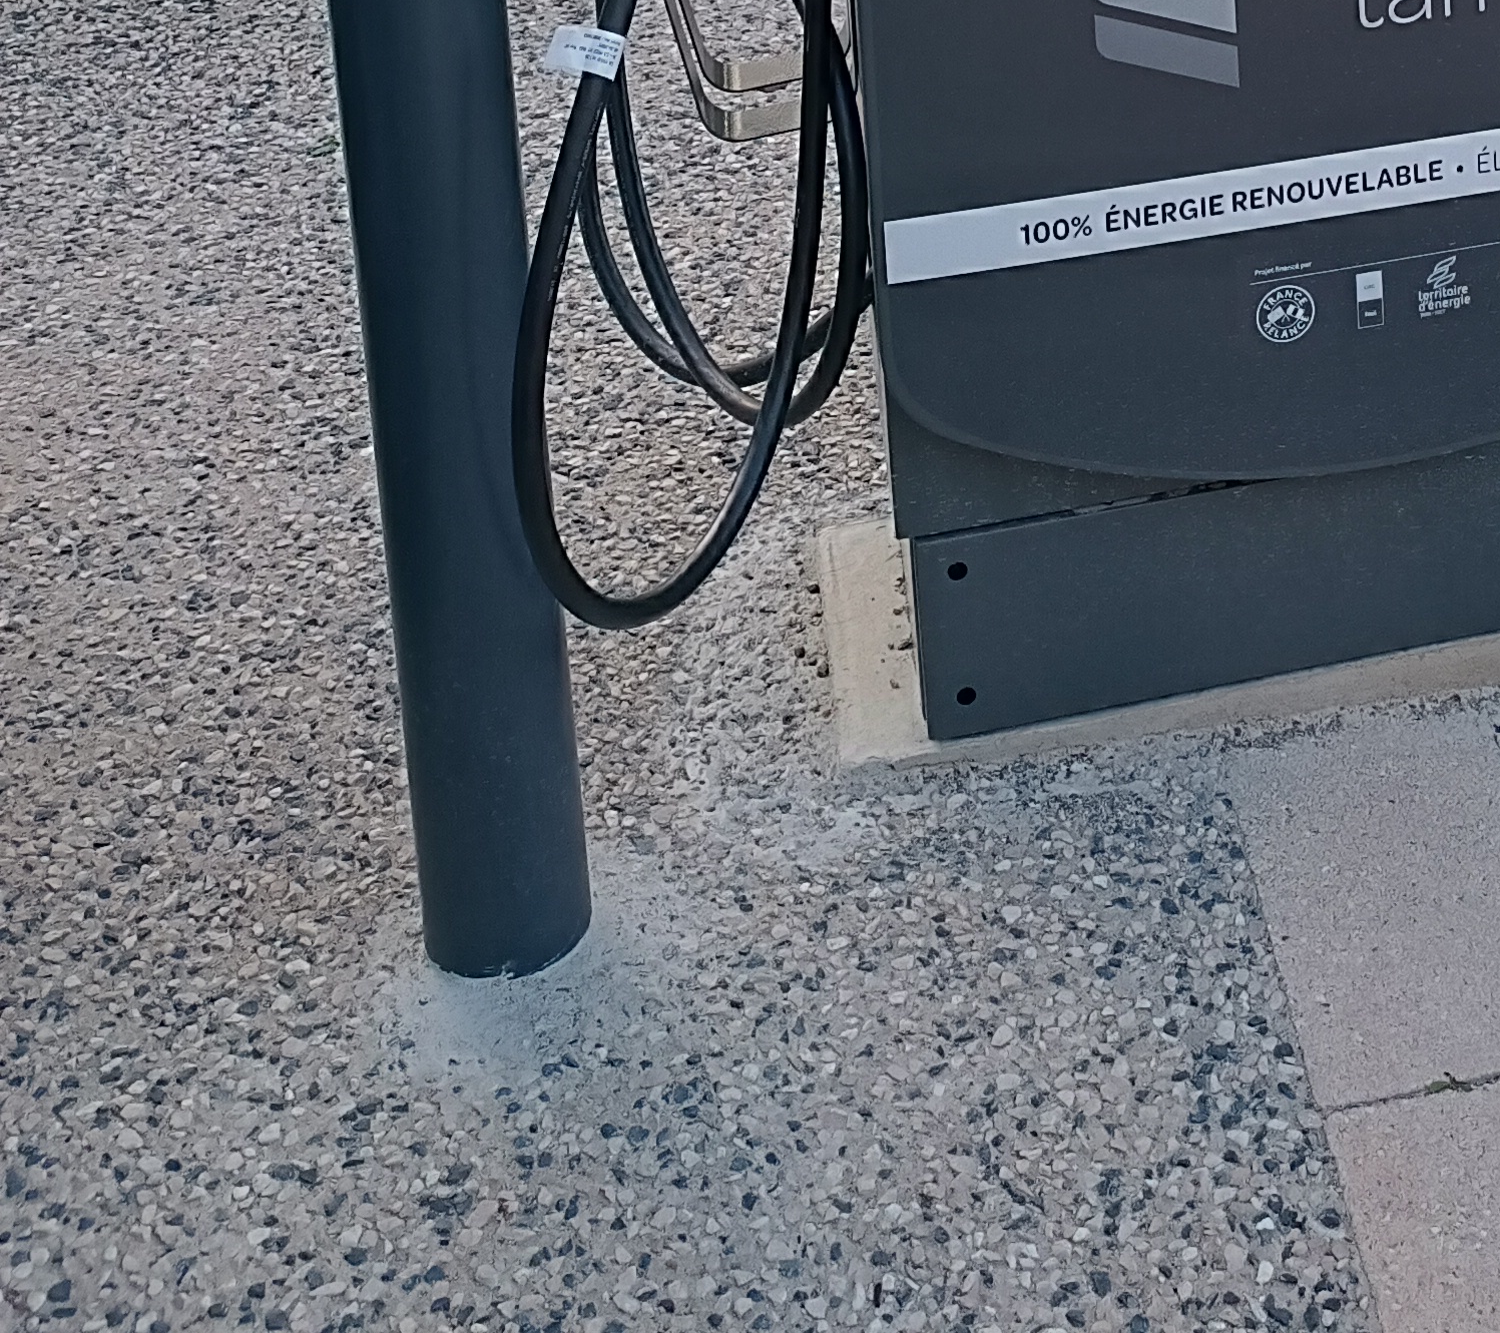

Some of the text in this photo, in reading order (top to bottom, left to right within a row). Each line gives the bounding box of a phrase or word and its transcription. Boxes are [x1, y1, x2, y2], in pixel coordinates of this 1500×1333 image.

[1020, 214, 1093, 245] 100%
[1105, 194, 1225, 233] ÉNERGIE
[1232, 159, 1443, 212] RENOUVELABLE
[1263, 289, 1308, 311] FRANCE
[1263, 315, 1310, 339] RELANCE
